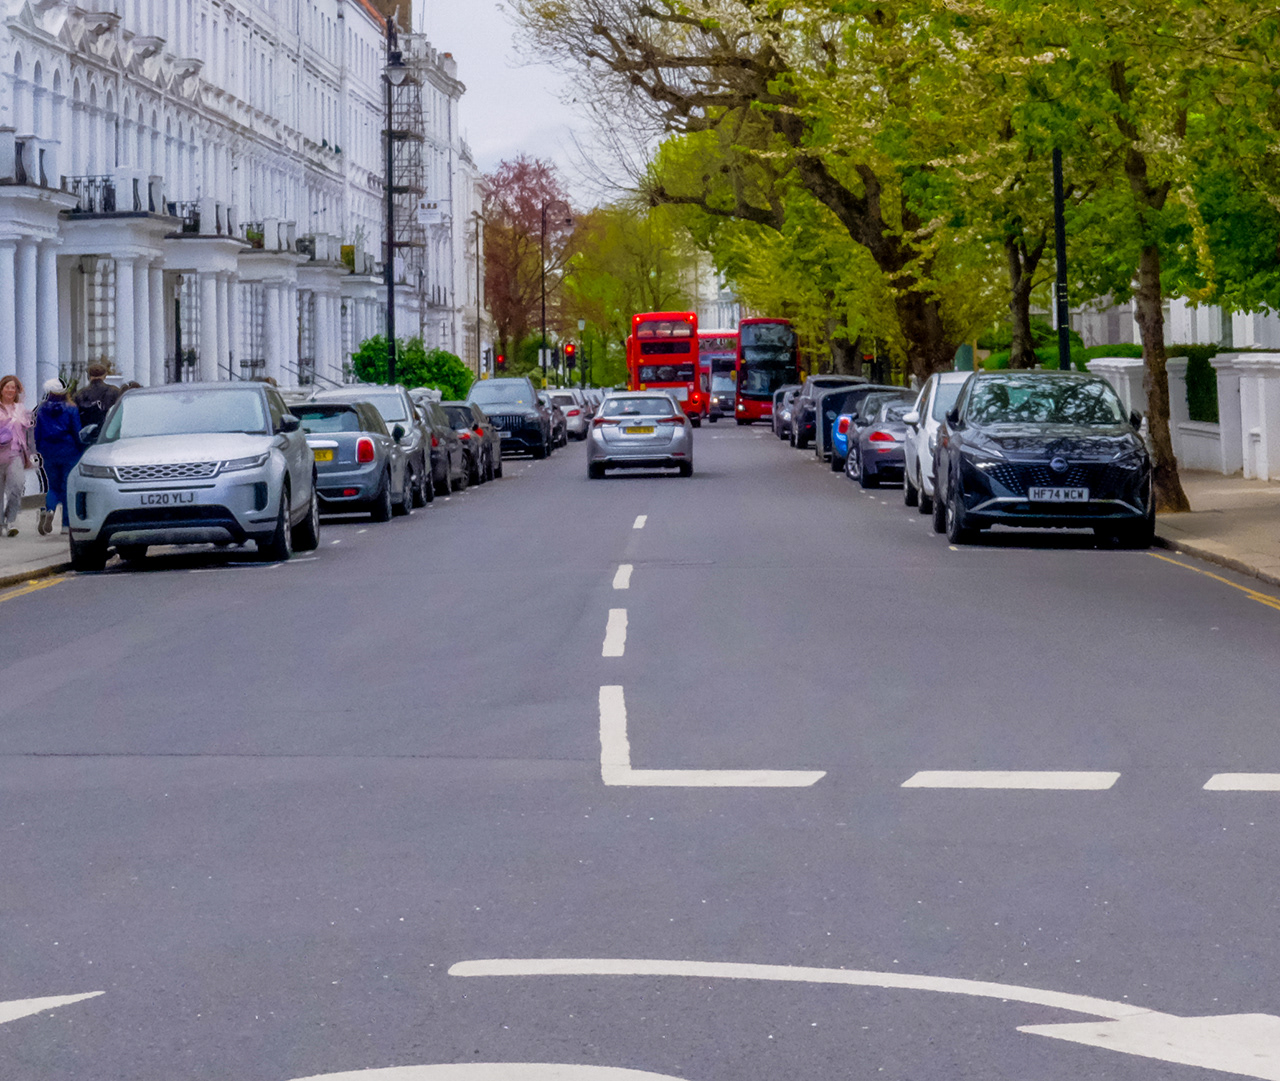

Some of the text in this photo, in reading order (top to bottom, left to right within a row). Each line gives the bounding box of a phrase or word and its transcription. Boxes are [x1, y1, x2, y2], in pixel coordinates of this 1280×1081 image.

[140, 492, 194, 505] LG20 YLJ
[1033, 489, 1061, 499] HF74
